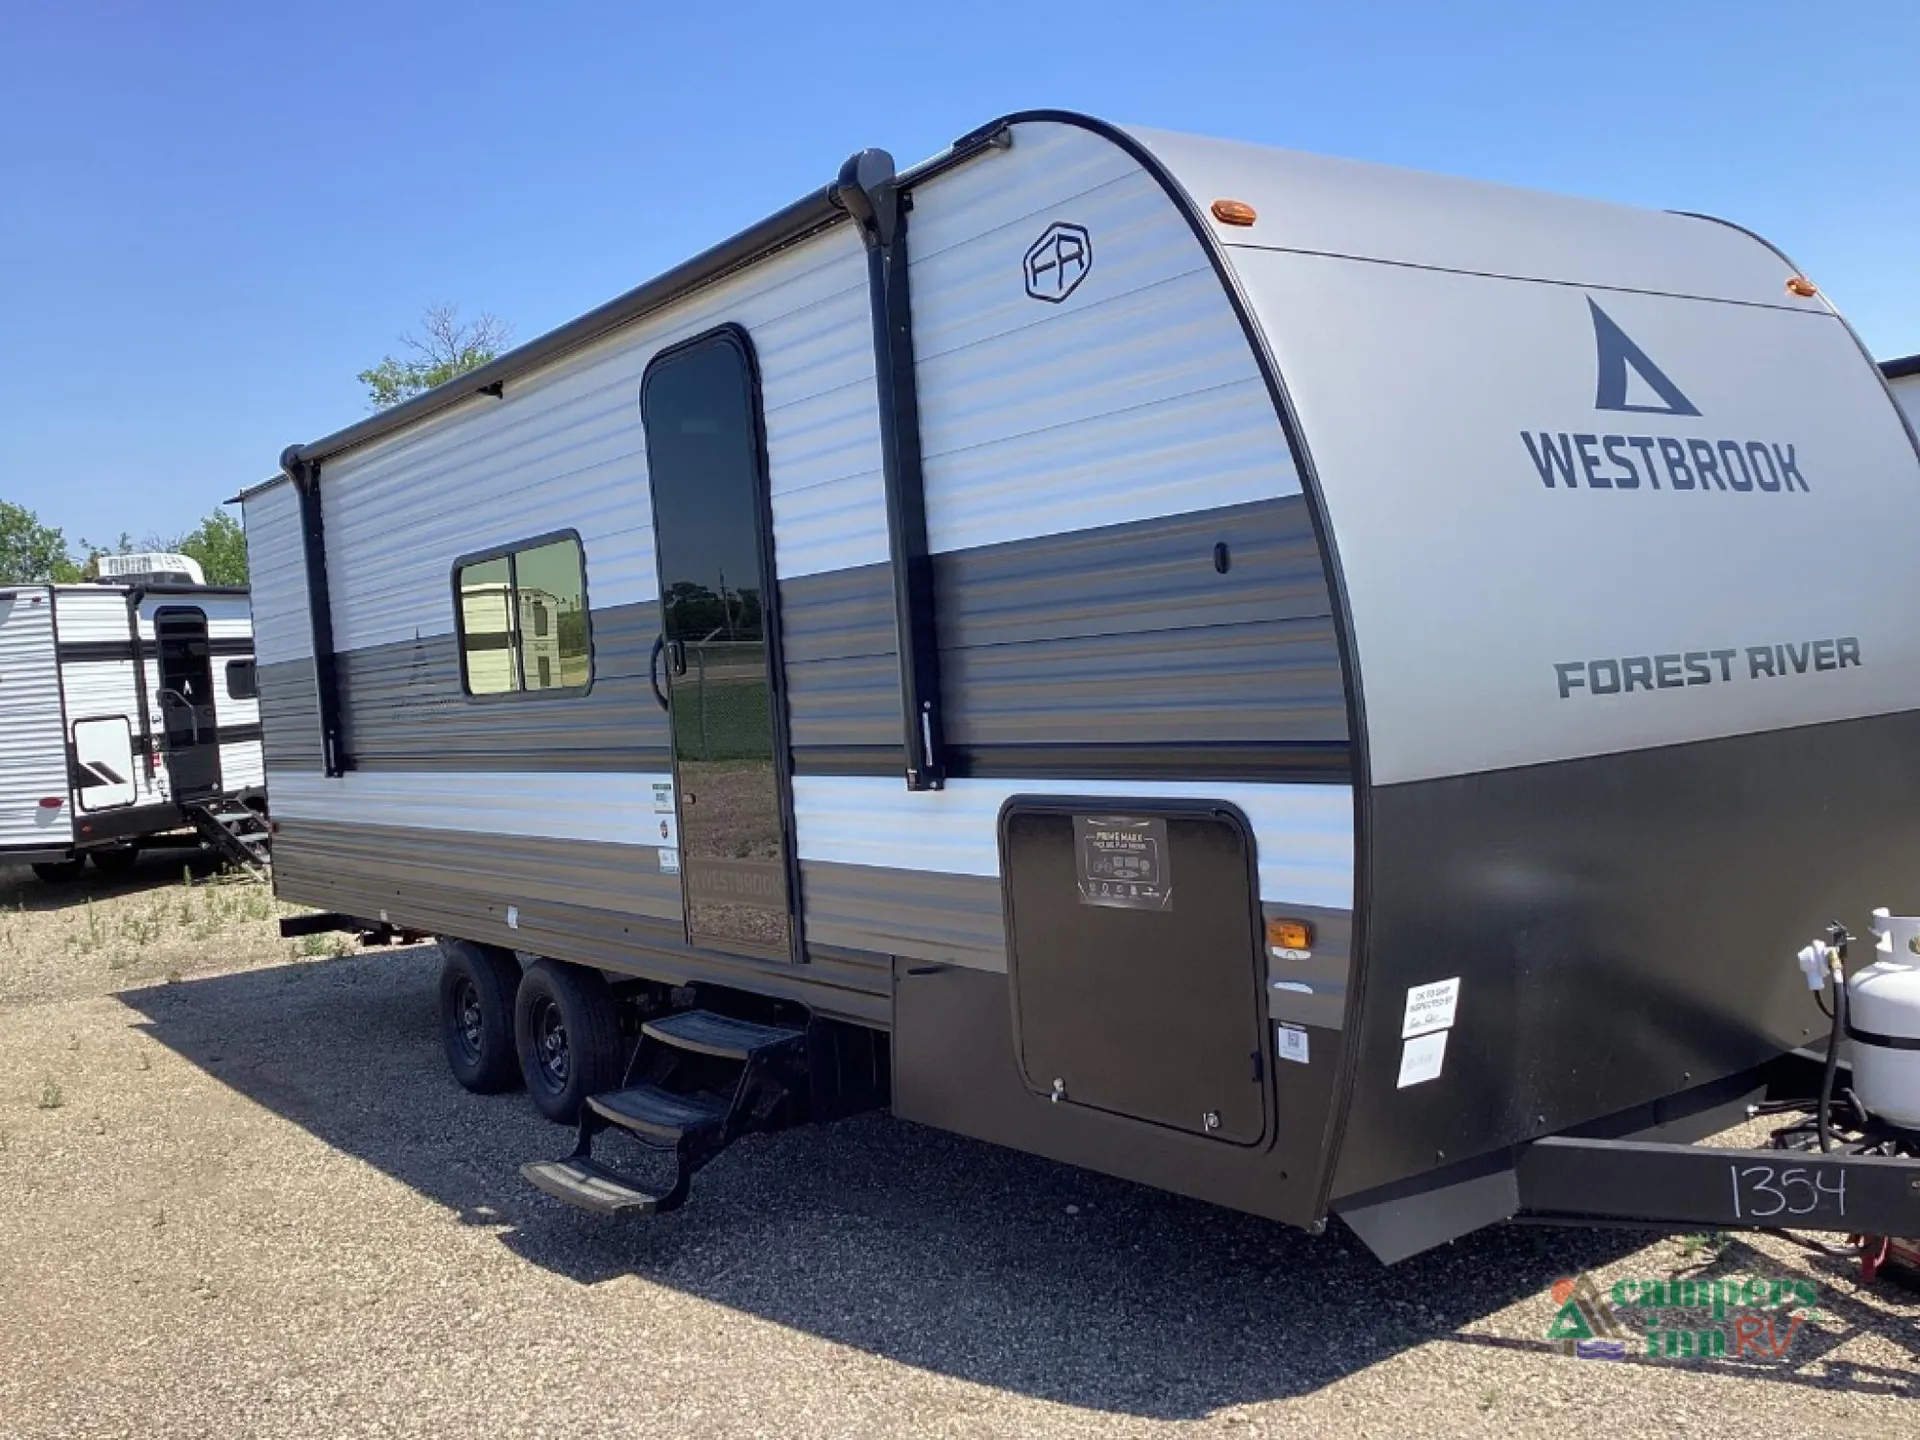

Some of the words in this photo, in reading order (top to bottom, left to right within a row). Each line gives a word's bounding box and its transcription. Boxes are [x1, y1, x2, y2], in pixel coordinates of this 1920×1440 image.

[1520, 430, 1810, 493] WESTBROOK
[1553, 648, 1737, 699] FOREST
[1745, 636, 1862, 680] RIVER
[1731, 1165, 1846, 1218] 1354
